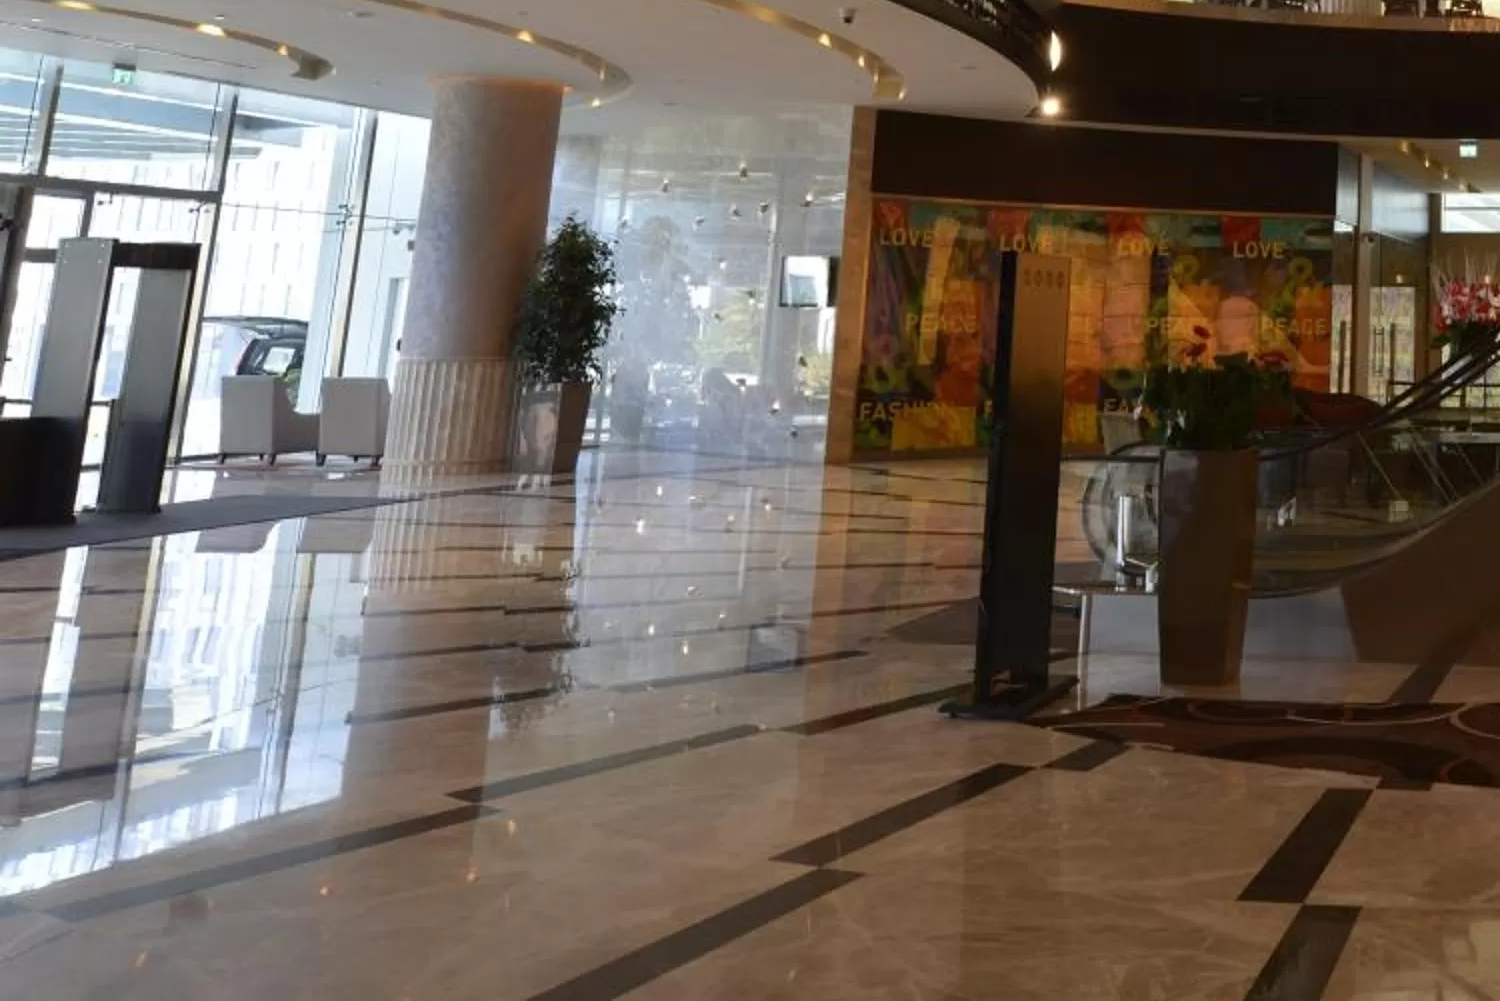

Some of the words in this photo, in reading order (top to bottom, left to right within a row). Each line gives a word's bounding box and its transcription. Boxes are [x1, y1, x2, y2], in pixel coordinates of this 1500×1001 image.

[879, 228, 933, 248] LOVE
[1000, 234, 1053, 255] LOVE
[1115, 237, 1170, 256] LOVE
[1233, 240, 1287, 260] LOVE
[905, 312, 978, 334] PEACE
[1261, 317, 1328, 336] PEACE
[858, 399, 952, 423] FASHI
